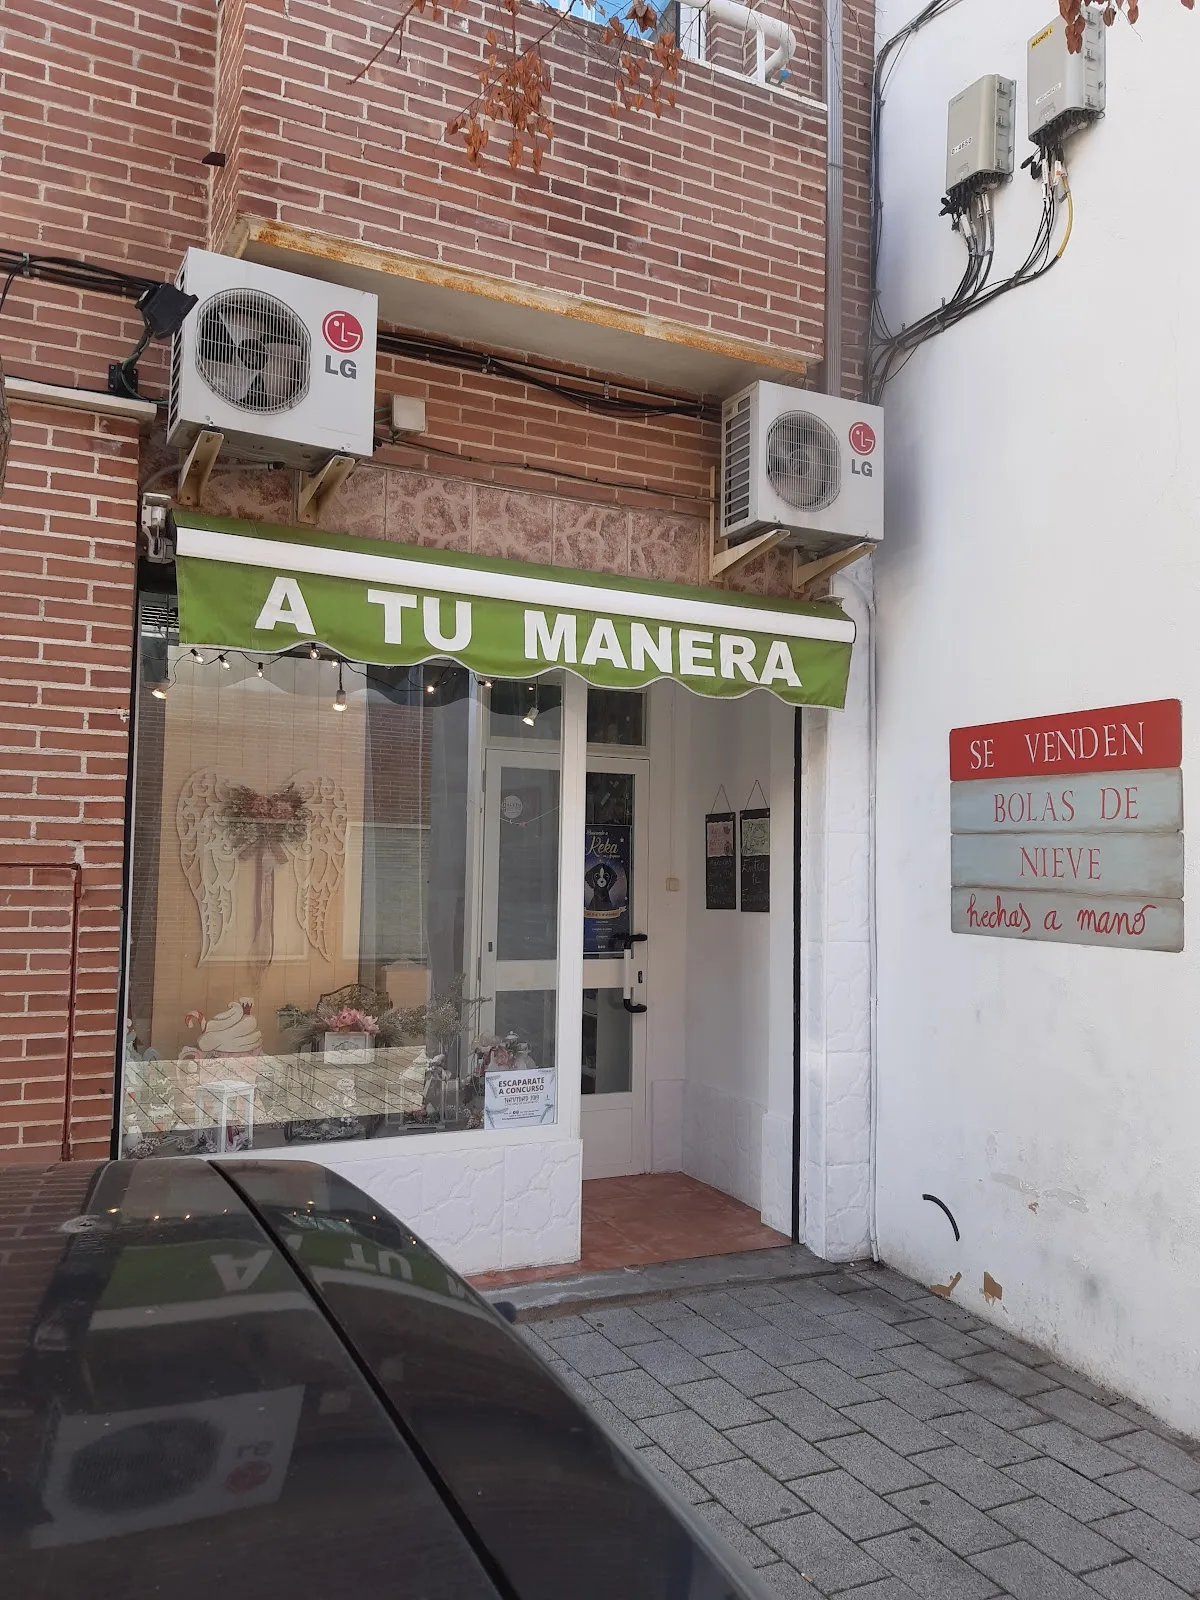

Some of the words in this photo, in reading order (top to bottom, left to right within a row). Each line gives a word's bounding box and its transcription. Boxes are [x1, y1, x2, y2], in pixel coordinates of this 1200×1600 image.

[324, 354, 357, 380] LG
[851, 458, 873, 478] LG
[254, 576, 317, 636] A
[367, 588, 472, 652] TU
[524, 609, 803, 687] MANERA
[970, 739, 995, 770] SE
[1024, 721, 1145, 764] VENDEN
[993, 790, 1075, 823] BOLAS
[1100, 786, 1140, 820] DE
[585, 835, 618, 857] Keka
[1019, 847, 1102, 880] NIEVE
[967, 893, 1031, 932] hechas
[1043, 910, 1063, 931] a
[498, 1077, 545, 1088] ESCAPARATE
[506, 1085, 544, 1094] CONCURSO
